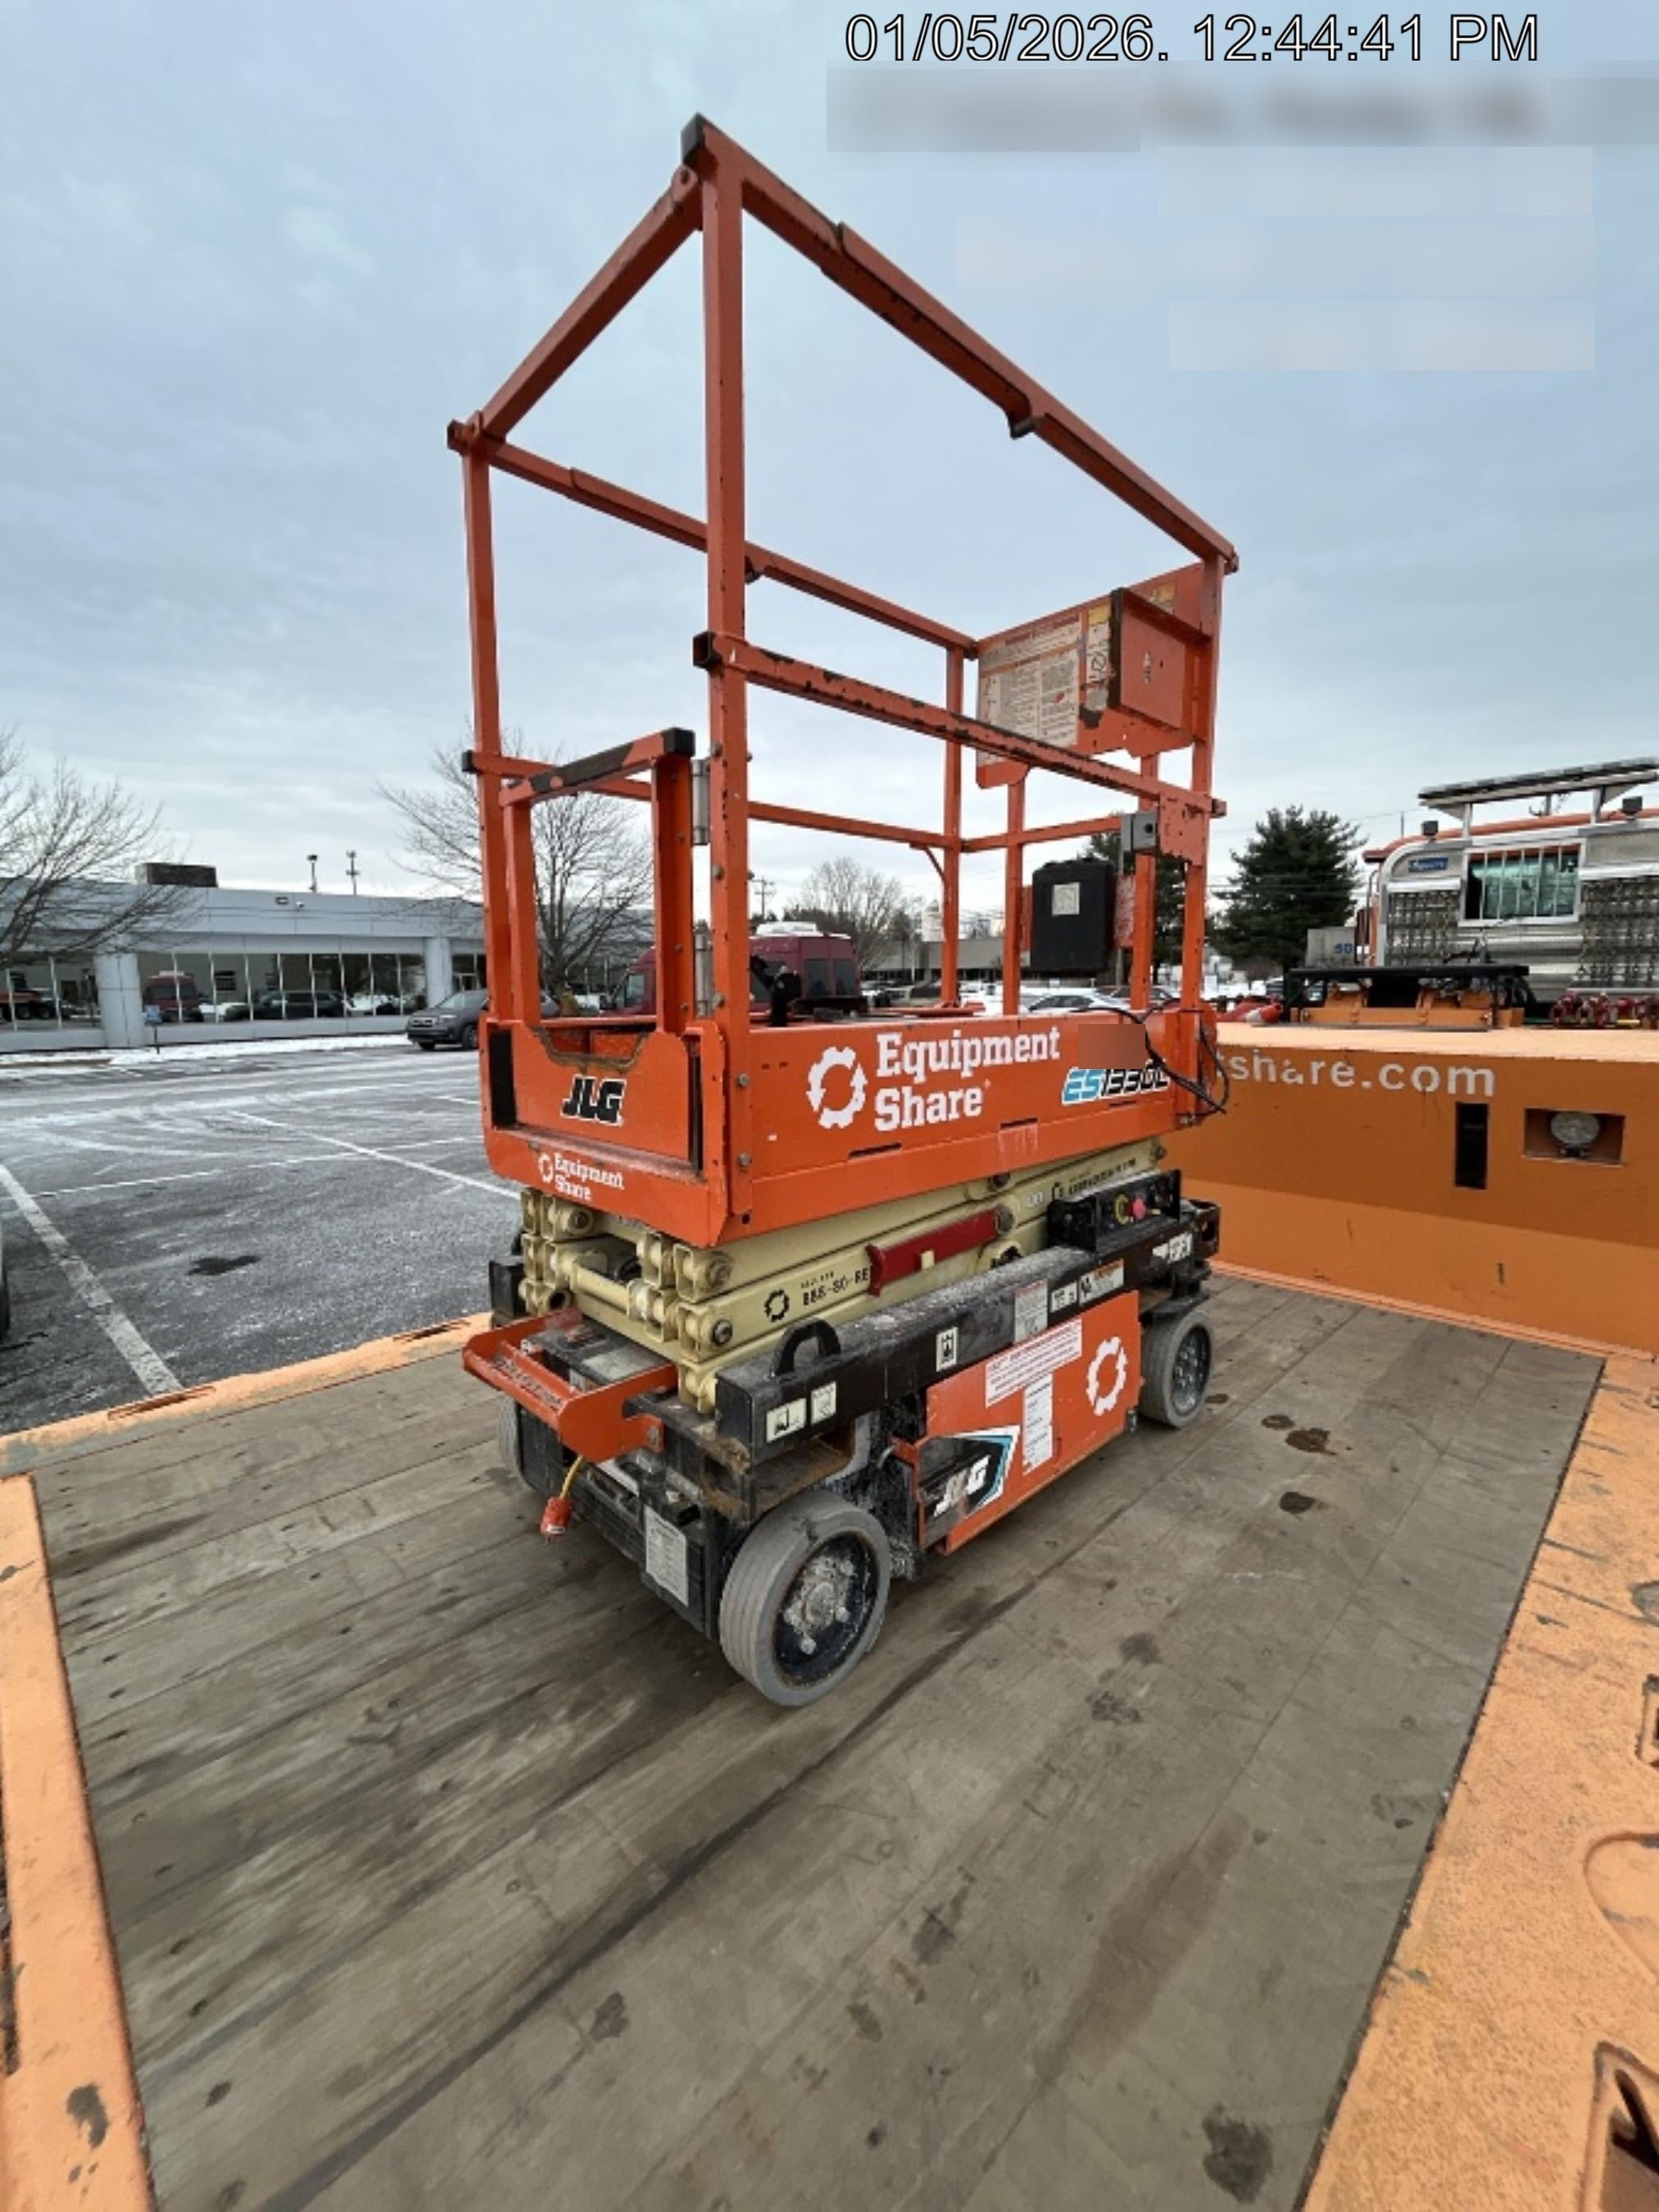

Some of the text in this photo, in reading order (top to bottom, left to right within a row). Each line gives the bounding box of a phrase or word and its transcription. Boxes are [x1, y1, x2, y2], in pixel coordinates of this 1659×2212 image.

[875, 1026, 1061, 1079] Equipment
[560, 1075, 627, 1126] JLG
[874, 1086, 983, 1131] Share
[554, 1152, 625, 1190] Equipment
